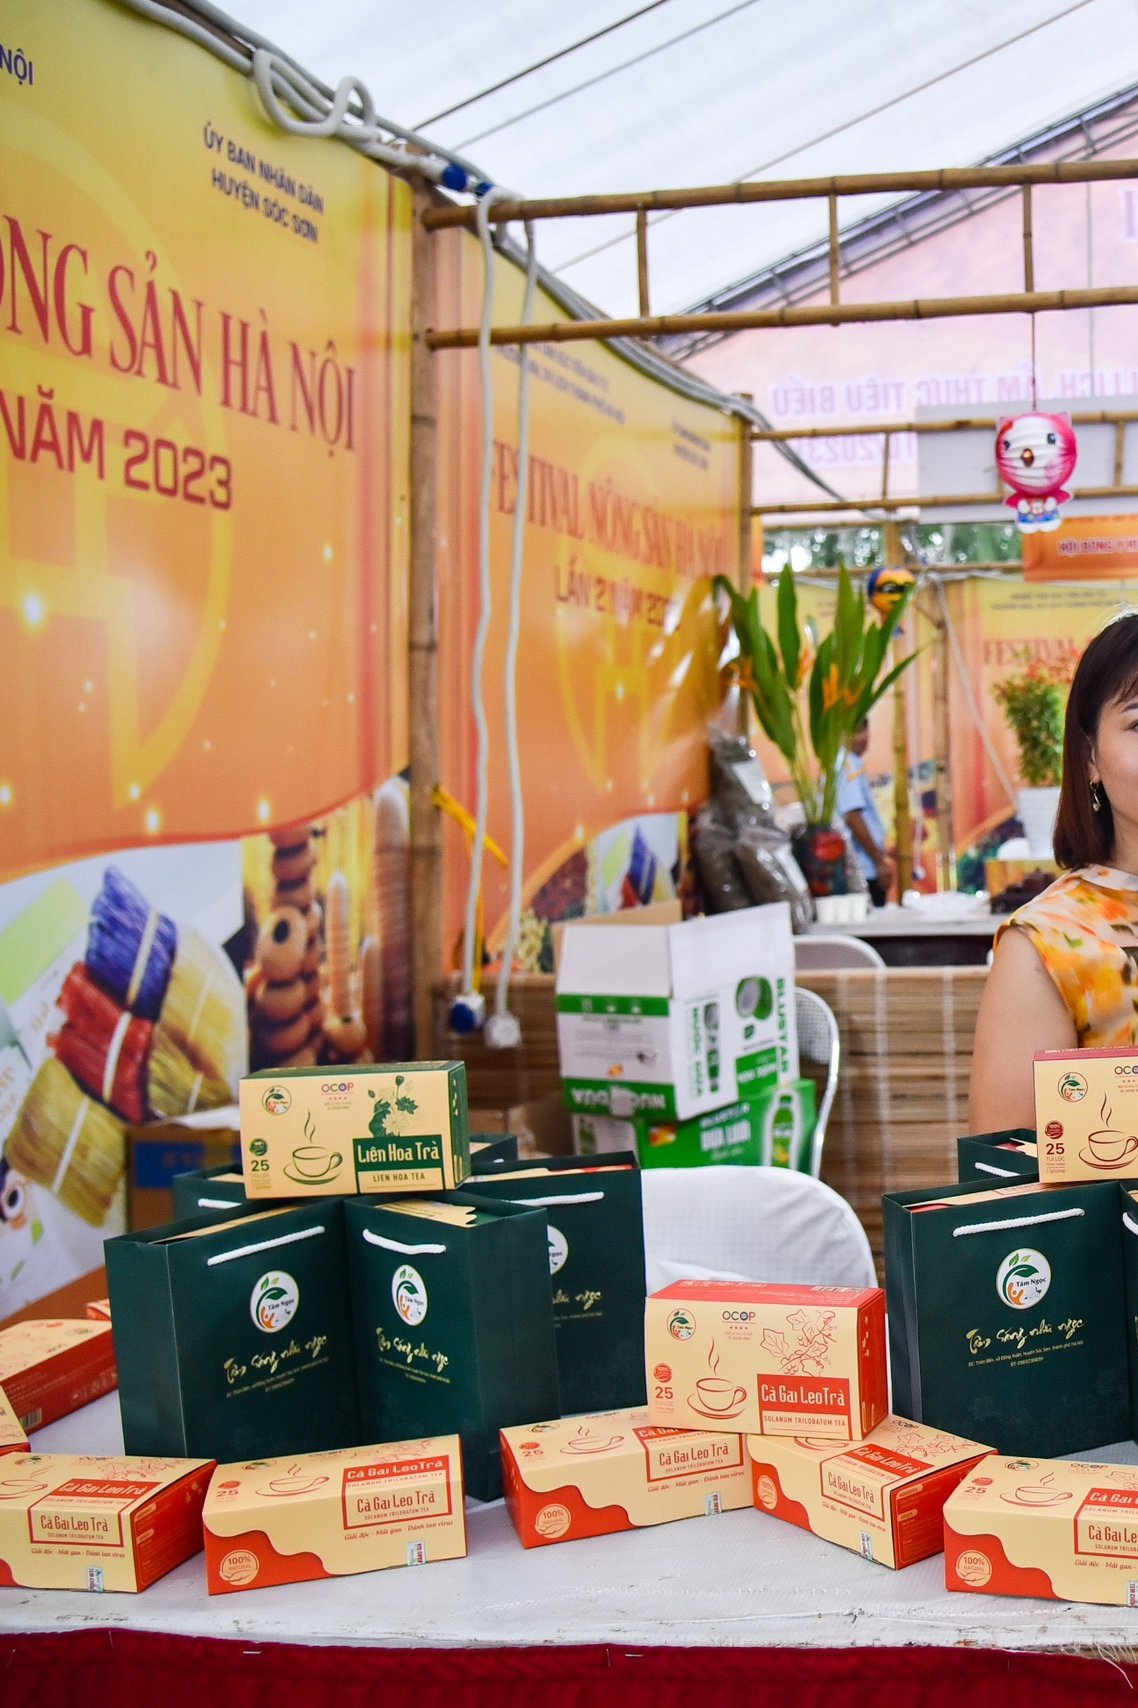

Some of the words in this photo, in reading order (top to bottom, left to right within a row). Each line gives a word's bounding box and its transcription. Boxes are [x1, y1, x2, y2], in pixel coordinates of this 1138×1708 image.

[0, 44, 33, 86] NỘI
[228, 140, 255, 173] BAN
[0, 214, 96, 359] NG
[109, 251, 205, 398] SẢN
[220, 307, 279, 424] HÀ
[288, 340, 356, 457] NỘI
[0, 384, 104, 480] NĂM
[124, 429, 232, 511] 2023
[493, 439, 583, 540] FETIVAL
[322, 1083, 354, 1093] OCOP
[358, 1142, 386, 1164] Liên
[389, 1143, 412, 1162] Hoa
[415, 1140, 439, 1160] Trà
[1046, 1142, 1065, 1155] 25
[251, 1160, 269, 1172] 25
[373, 1174, 390, 1182] LIEN
[393, 1173, 409, 1181] HOA
[412, 1173, 425, 1181] TEA
[1016, 1280, 1030, 1289] Tâm
[1031, 1277, 1046, 1287] Ngọc
[722, 1310, 756, 1321] OCOP
[655, 1387, 673, 1399] 25
[761, 1385, 777, 1403] Cà
[779, 1387, 797, 1404] Gai
[764, 1415, 793, 1424] SOLANUM
[795, 1417, 832, 1426] TRILOBATUM
[835, 1418, 846, 1426] TEA
[659, 1451, 672, 1466] Cà
[674, 1449, 690, 1465] Gai
[691, 1447, 709, 1462] Leo
[710, 1443, 729, 1458] Trà
[347, 1470, 364, 1479] Cà
[367, 1466, 390, 1478] Gai
[216, 1490, 239, 1498] 25
[964, 1486, 987, 1495] 25
[357, 1498, 371, 1513] Cà
[373, 1495, 390, 1512] Gai
[393, 1493, 413, 1509] Leo
[416, 1490, 435, 1505] Trà
[1090, 1491, 1107, 1502] Cà
[1110, 1493, 1132, 1504] Gai
[41, 1515, 52, 1529] Cà
[55, 1516, 70, 1530] Gai
[71, 1517, 88, 1530] Leo
[91, 1517, 108, 1532] Trà
[1088, 1524, 1102, 1541] Cà
[1105, 1526, 1122, 1543] Gai
[228, 1556, 251, 1564] 100%
[963, 1556, 985, 1565] 100%
